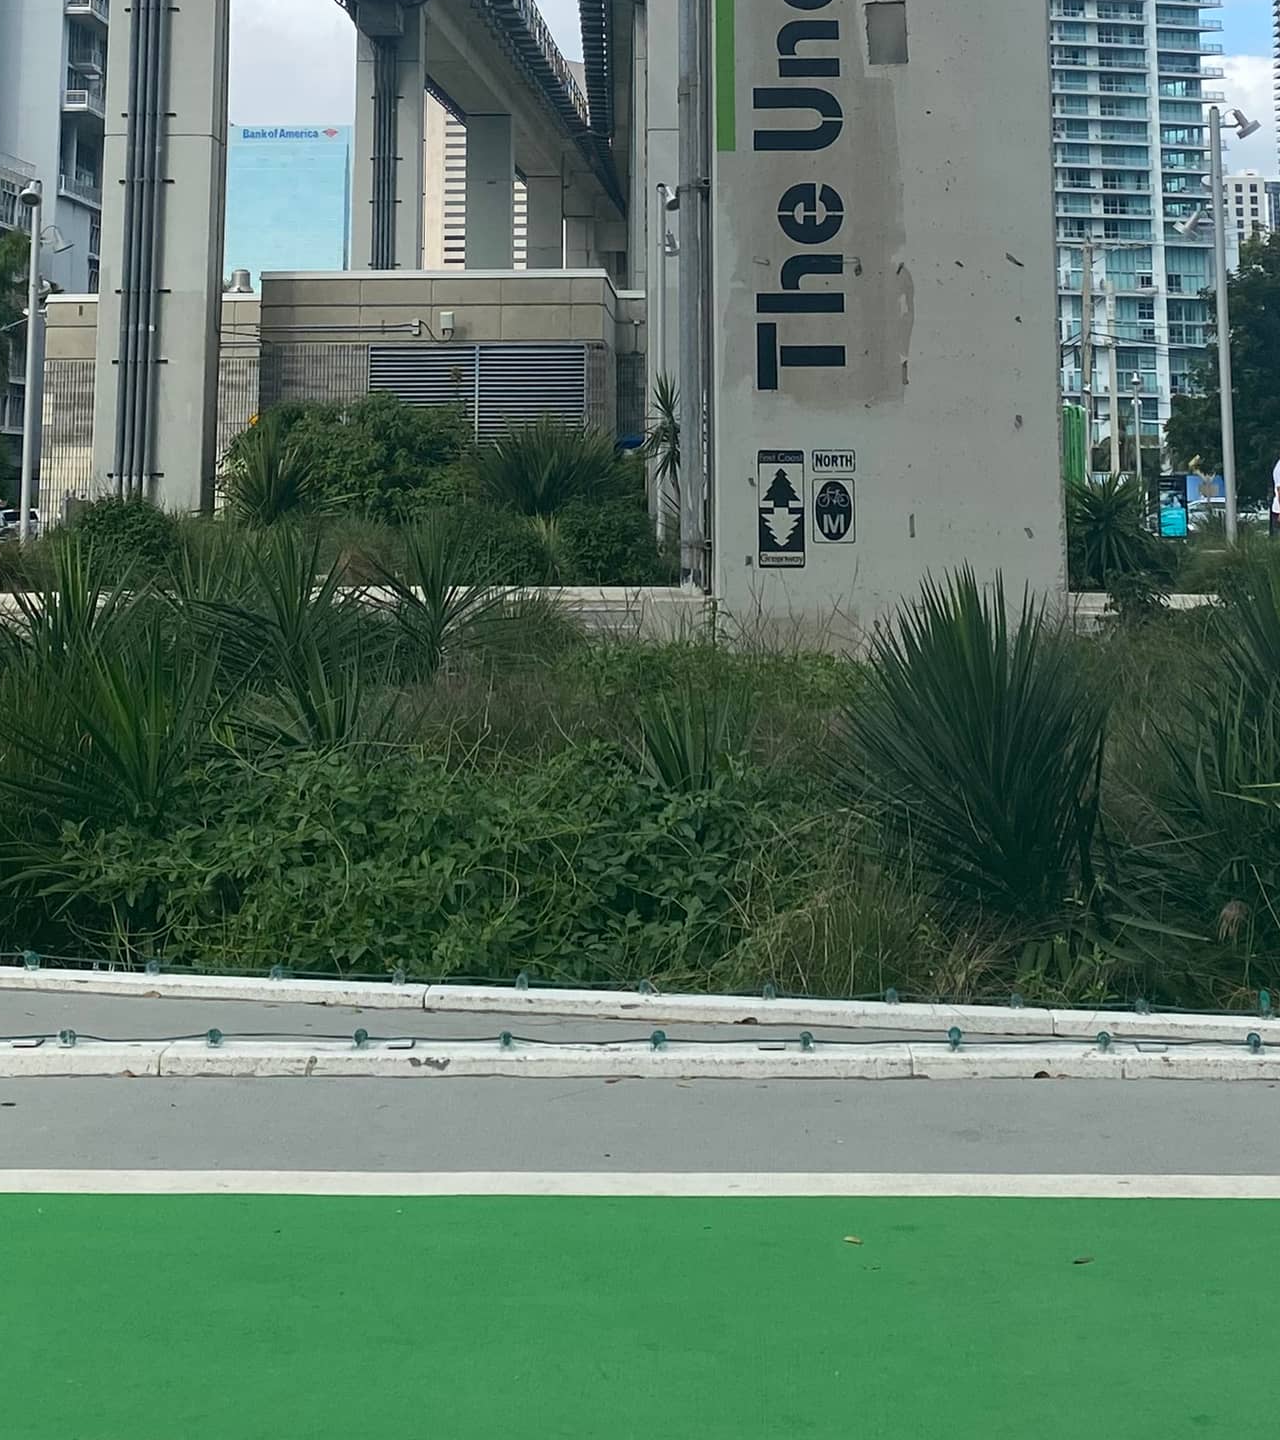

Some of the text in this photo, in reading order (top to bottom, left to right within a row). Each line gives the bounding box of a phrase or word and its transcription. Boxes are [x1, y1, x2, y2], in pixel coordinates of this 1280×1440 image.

[242, 128, 319, 139] Bank of America
[756, 182, 846, 391] The
[815, 453, 853, 468] NORTH
[823, 513, 845, 534] M
